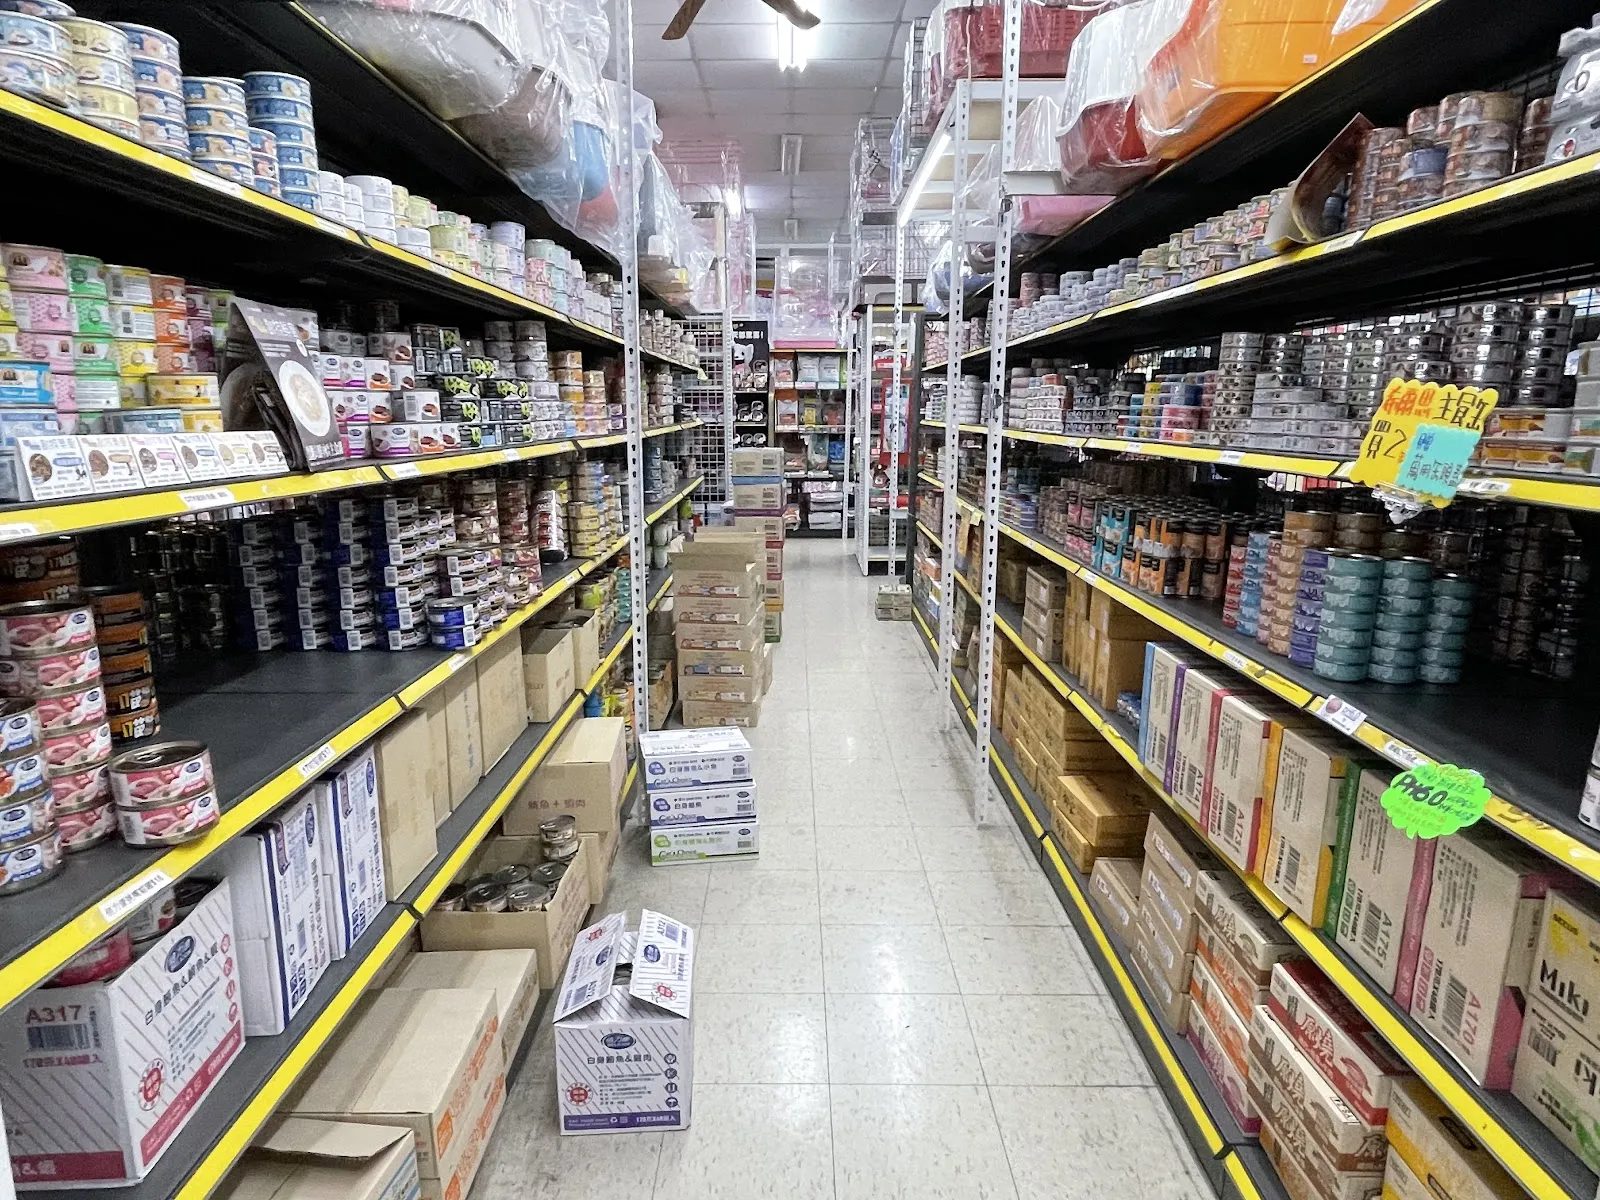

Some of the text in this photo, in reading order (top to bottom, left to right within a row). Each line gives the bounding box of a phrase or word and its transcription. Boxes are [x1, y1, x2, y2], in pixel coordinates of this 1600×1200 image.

[1193, 768, 1204, 804] A174
[1235, 809, 1245, 849] A173
[1375, 915, 1392, 963] A175
[1539, 959, 1590, 1017] Miki
[24, 1005, 82, 1024] A317
[1461, 990, 1481, 1046] A170
